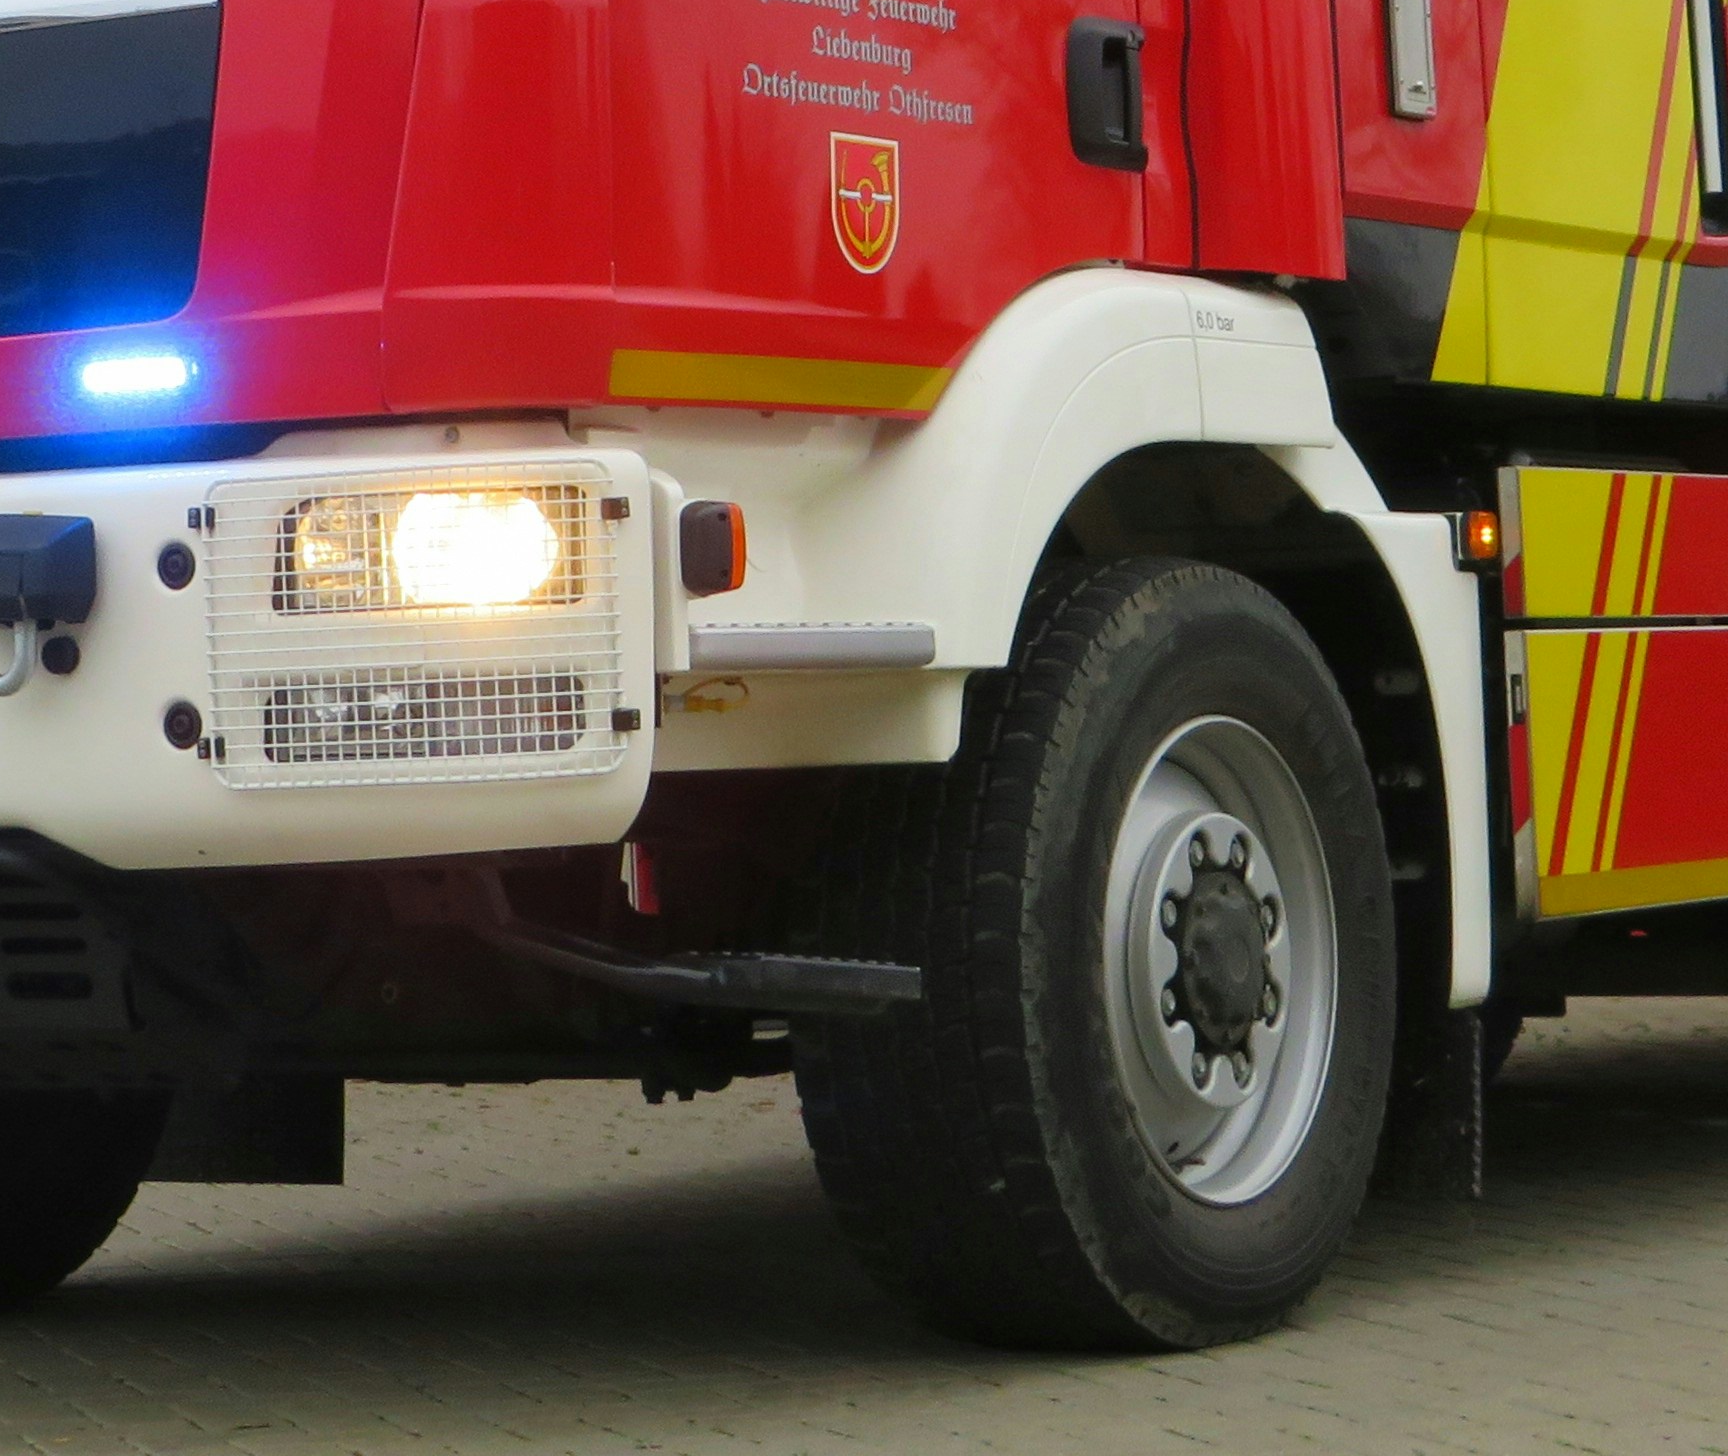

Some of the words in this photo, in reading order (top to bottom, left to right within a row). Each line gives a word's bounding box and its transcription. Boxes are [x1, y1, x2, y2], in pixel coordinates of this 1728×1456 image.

[811, 24, 913, 75] Liebenburg
[742, 63, 881, 113] Ortsfeuerwehr
[888, 83, 974, 124] Othfresen
[1196, 310, 1214, 332] 6,0
[1216, 311, 1234, 332] bar
